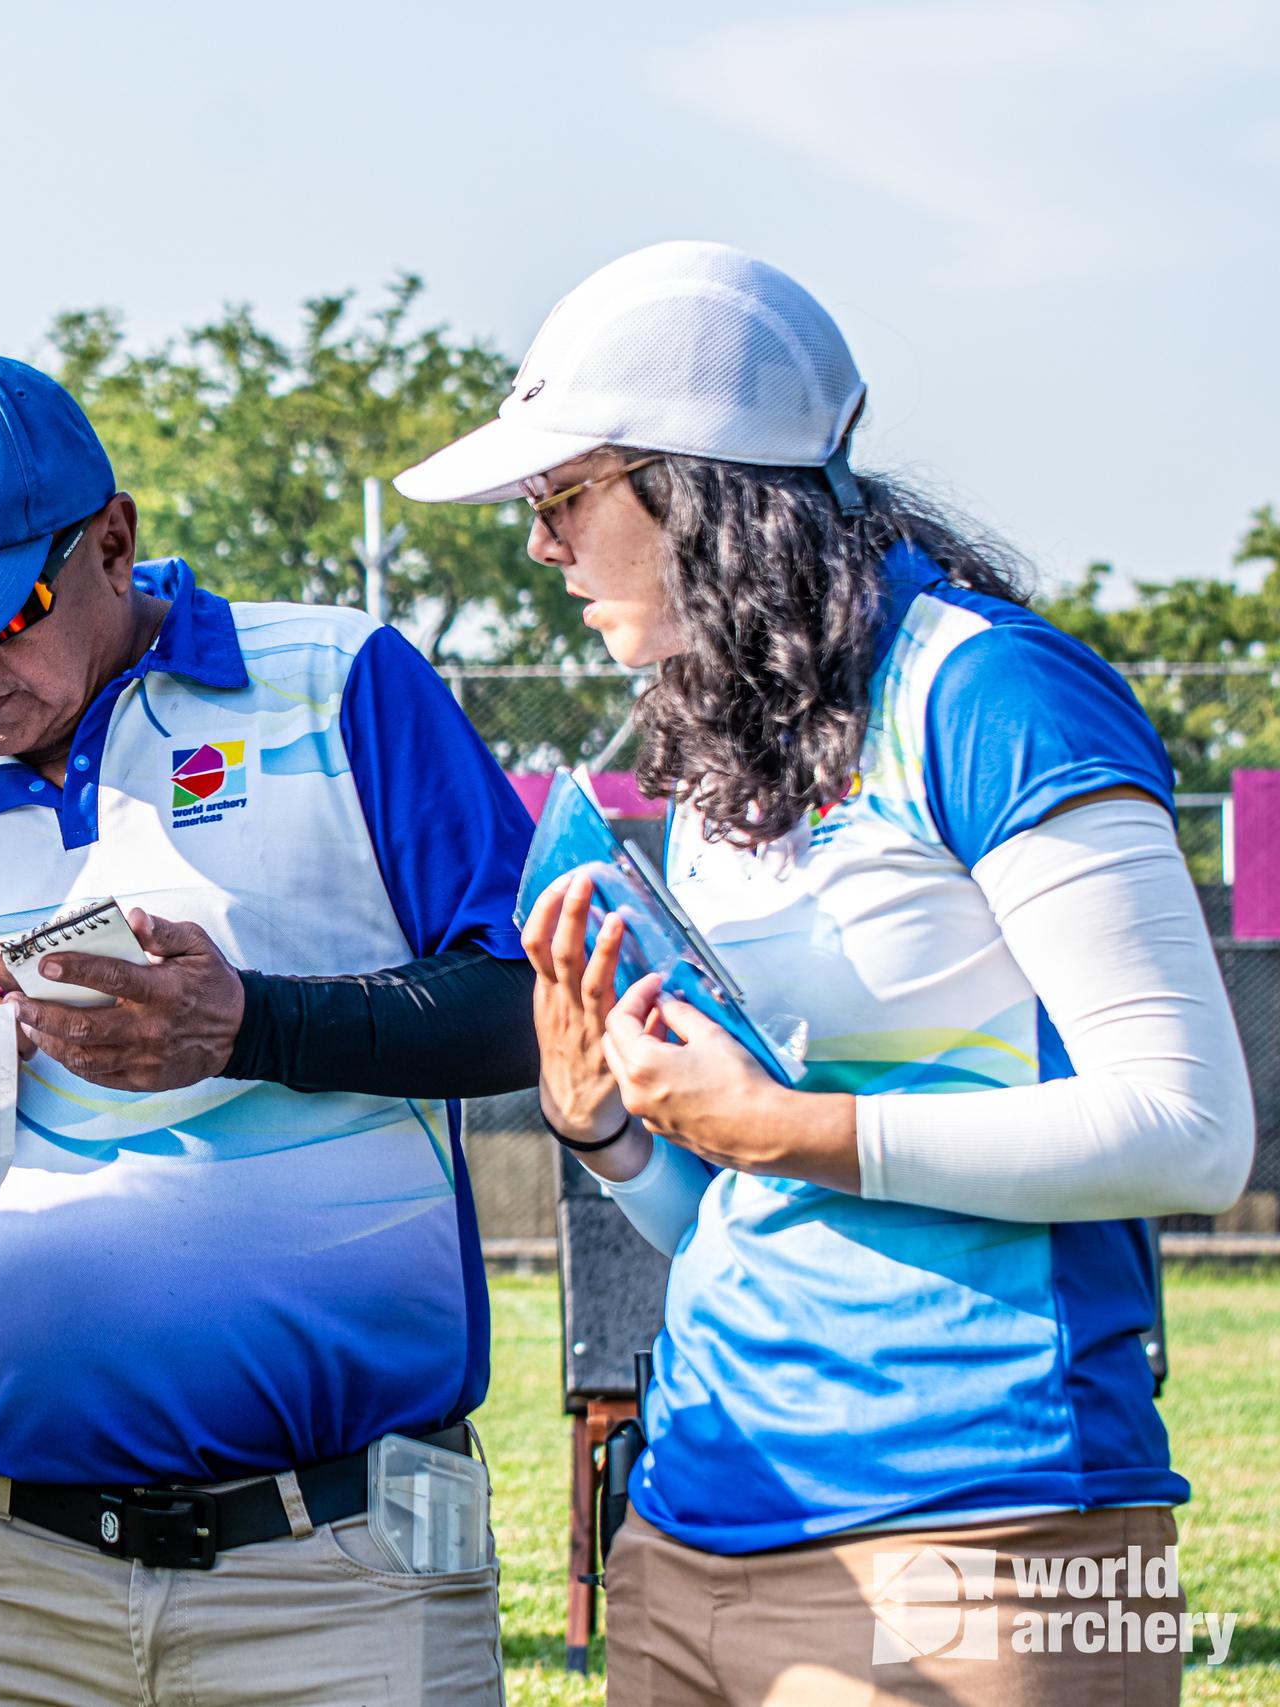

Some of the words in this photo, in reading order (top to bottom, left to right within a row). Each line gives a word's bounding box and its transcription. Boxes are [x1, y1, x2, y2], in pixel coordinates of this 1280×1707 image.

[172, 804, 203, 817] world
[206, 798, 247, 812] archery
[172, 813, 223, 829] americas
